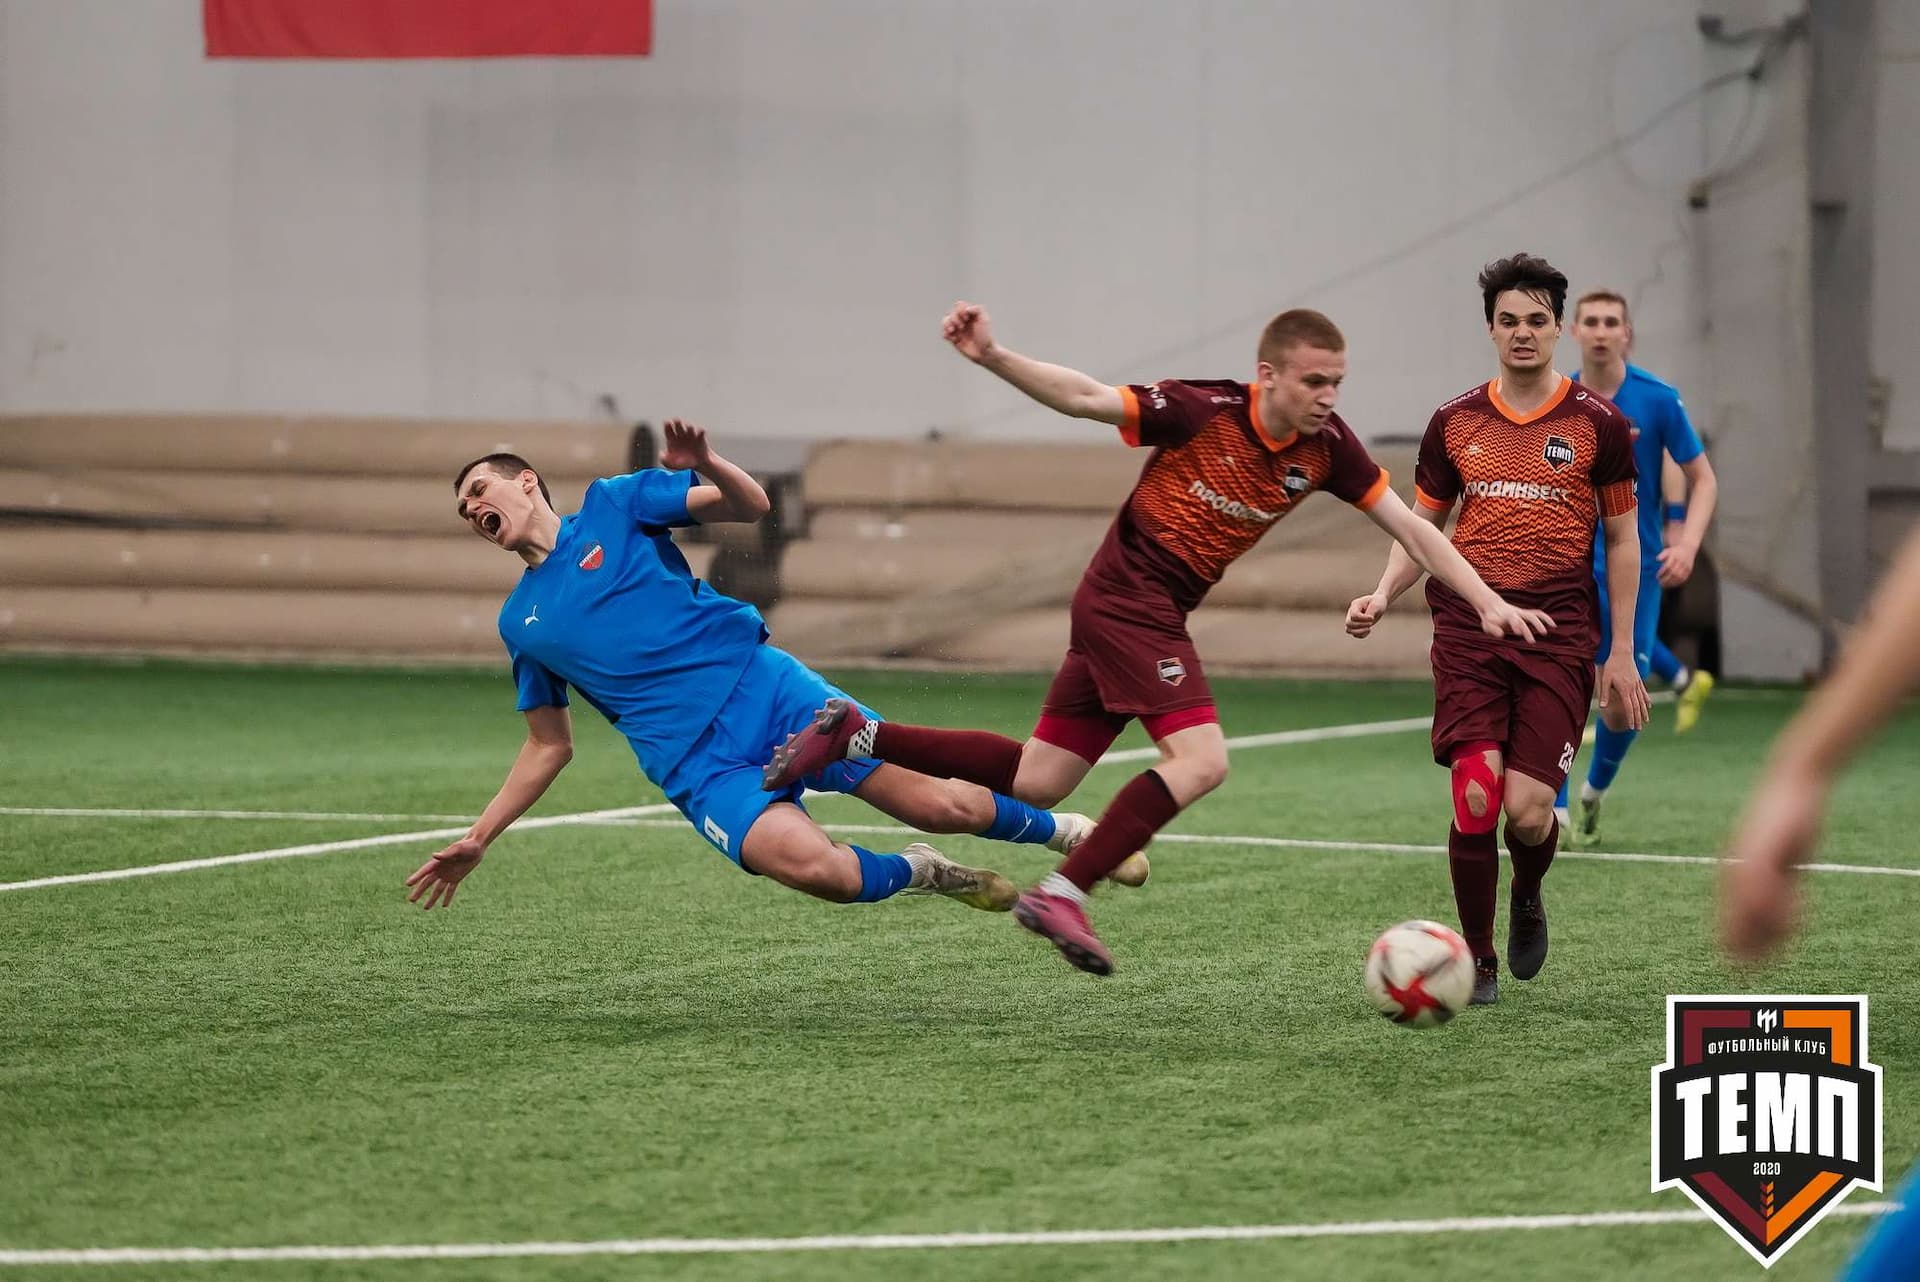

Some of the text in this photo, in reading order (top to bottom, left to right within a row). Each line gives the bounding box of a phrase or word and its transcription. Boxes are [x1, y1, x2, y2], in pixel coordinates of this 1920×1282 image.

[1547, 445, 1571, 462] ТЕМП
[1463, 480, 1569, 502] РОДИНВЕСТ
[1558, 741, 1575, 775] 23
